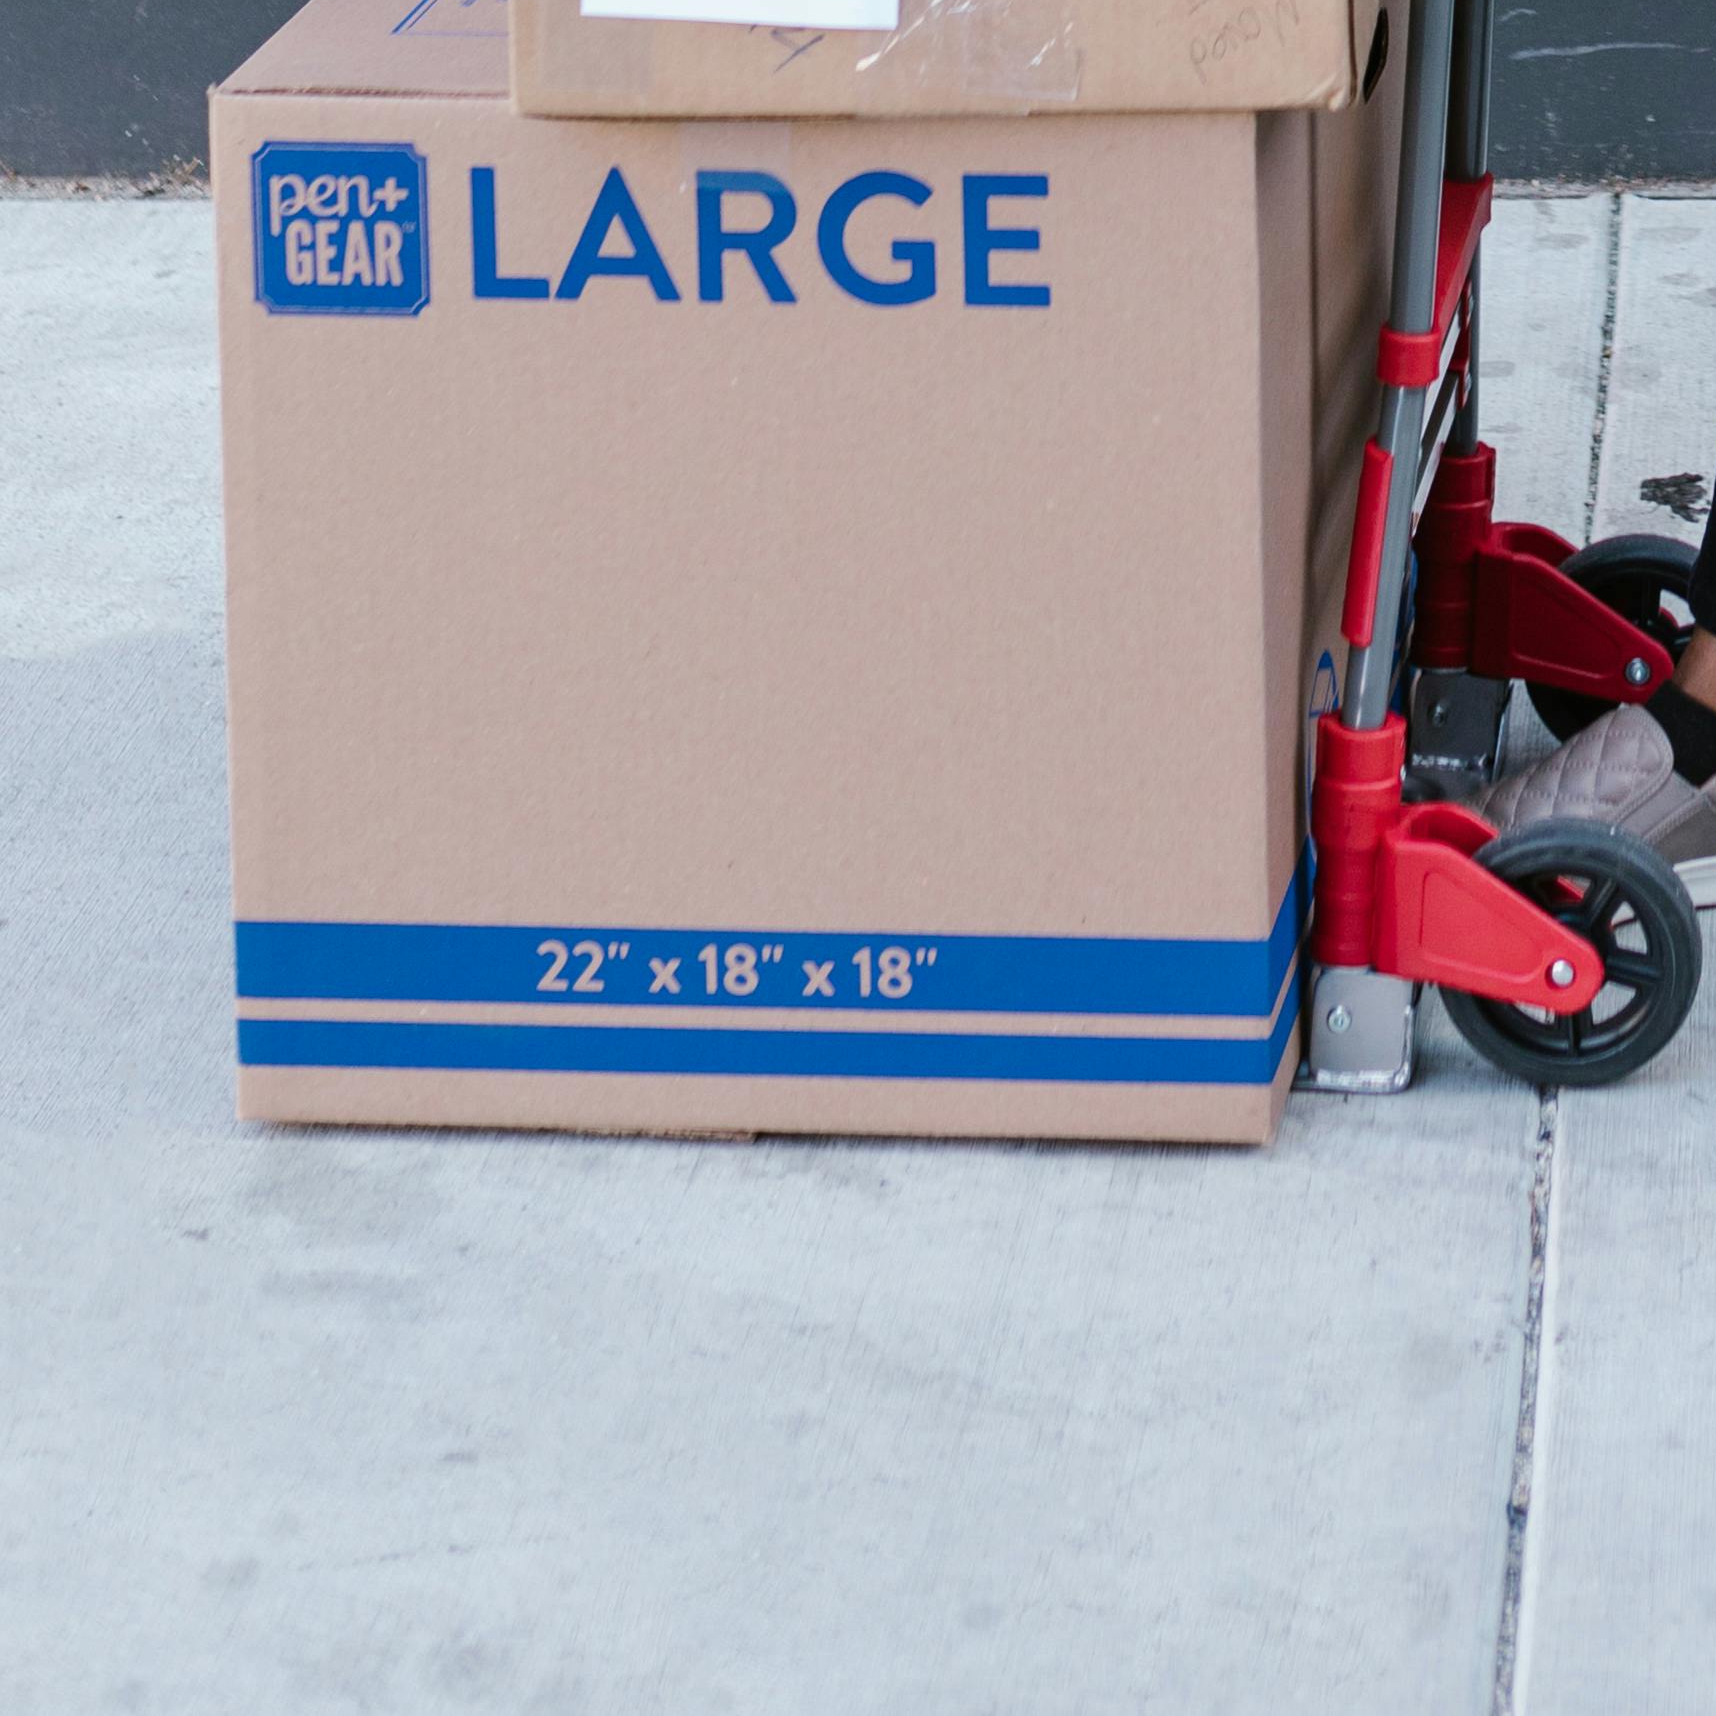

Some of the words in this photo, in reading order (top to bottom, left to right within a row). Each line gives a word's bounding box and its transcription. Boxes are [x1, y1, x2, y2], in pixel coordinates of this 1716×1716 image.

[269, 174, 409, 237] pen+
[470, 166, 1051, 307] LARGE
[285, 218, 404, 287] GEAR
[536, 939, 630, 993] 22"
[648, 957, 681, 994] x
[698, 943, 784, 996] 18"
[802, 960, 835, 997] x
[852, 946, 938, 999] 18"
